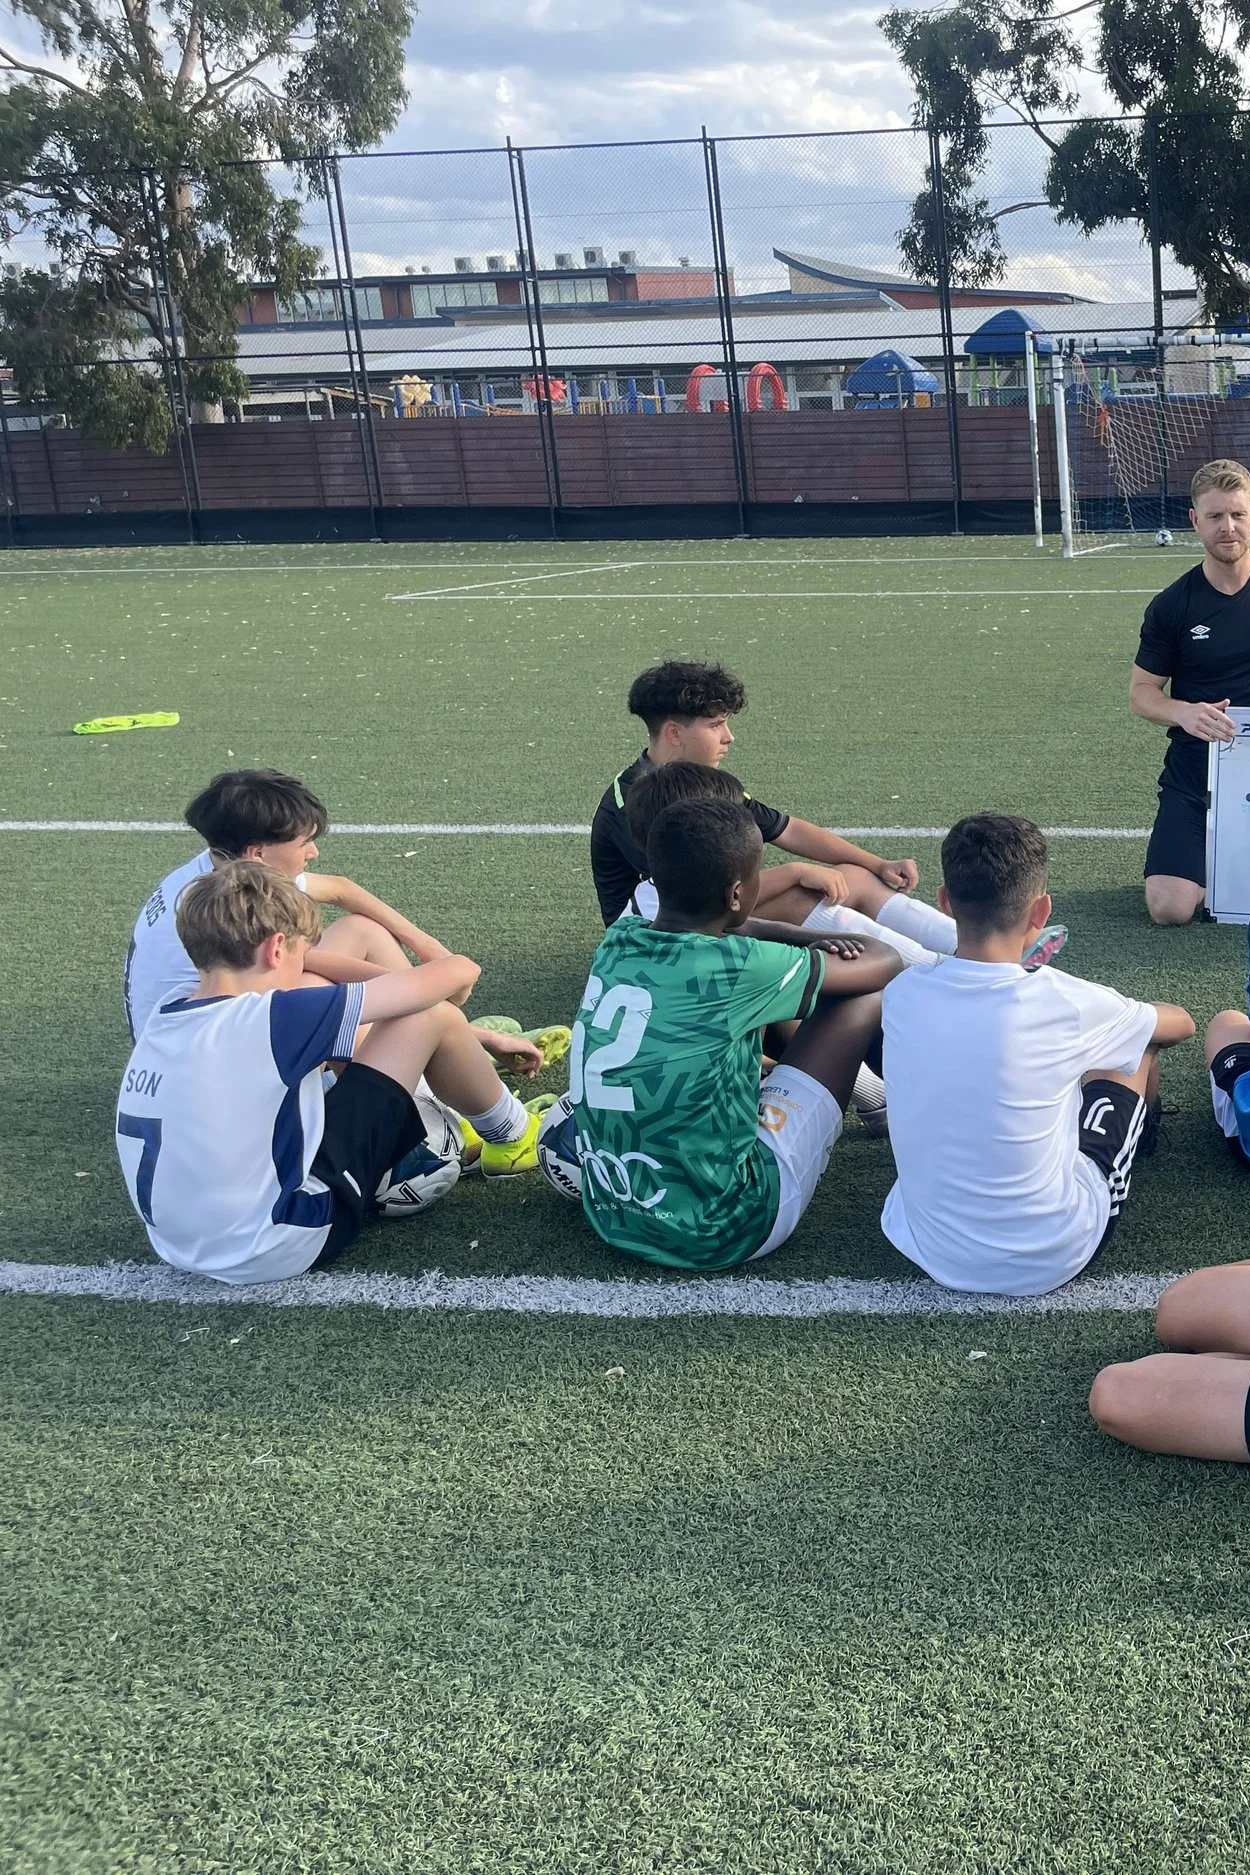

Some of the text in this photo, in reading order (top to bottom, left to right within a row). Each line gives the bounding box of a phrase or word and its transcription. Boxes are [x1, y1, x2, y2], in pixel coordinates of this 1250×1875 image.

[125, 1068, 164, 1098] SON
[117, 1111, 163, 1228] 7
[548, 1163, 583, 1198] Mitr
